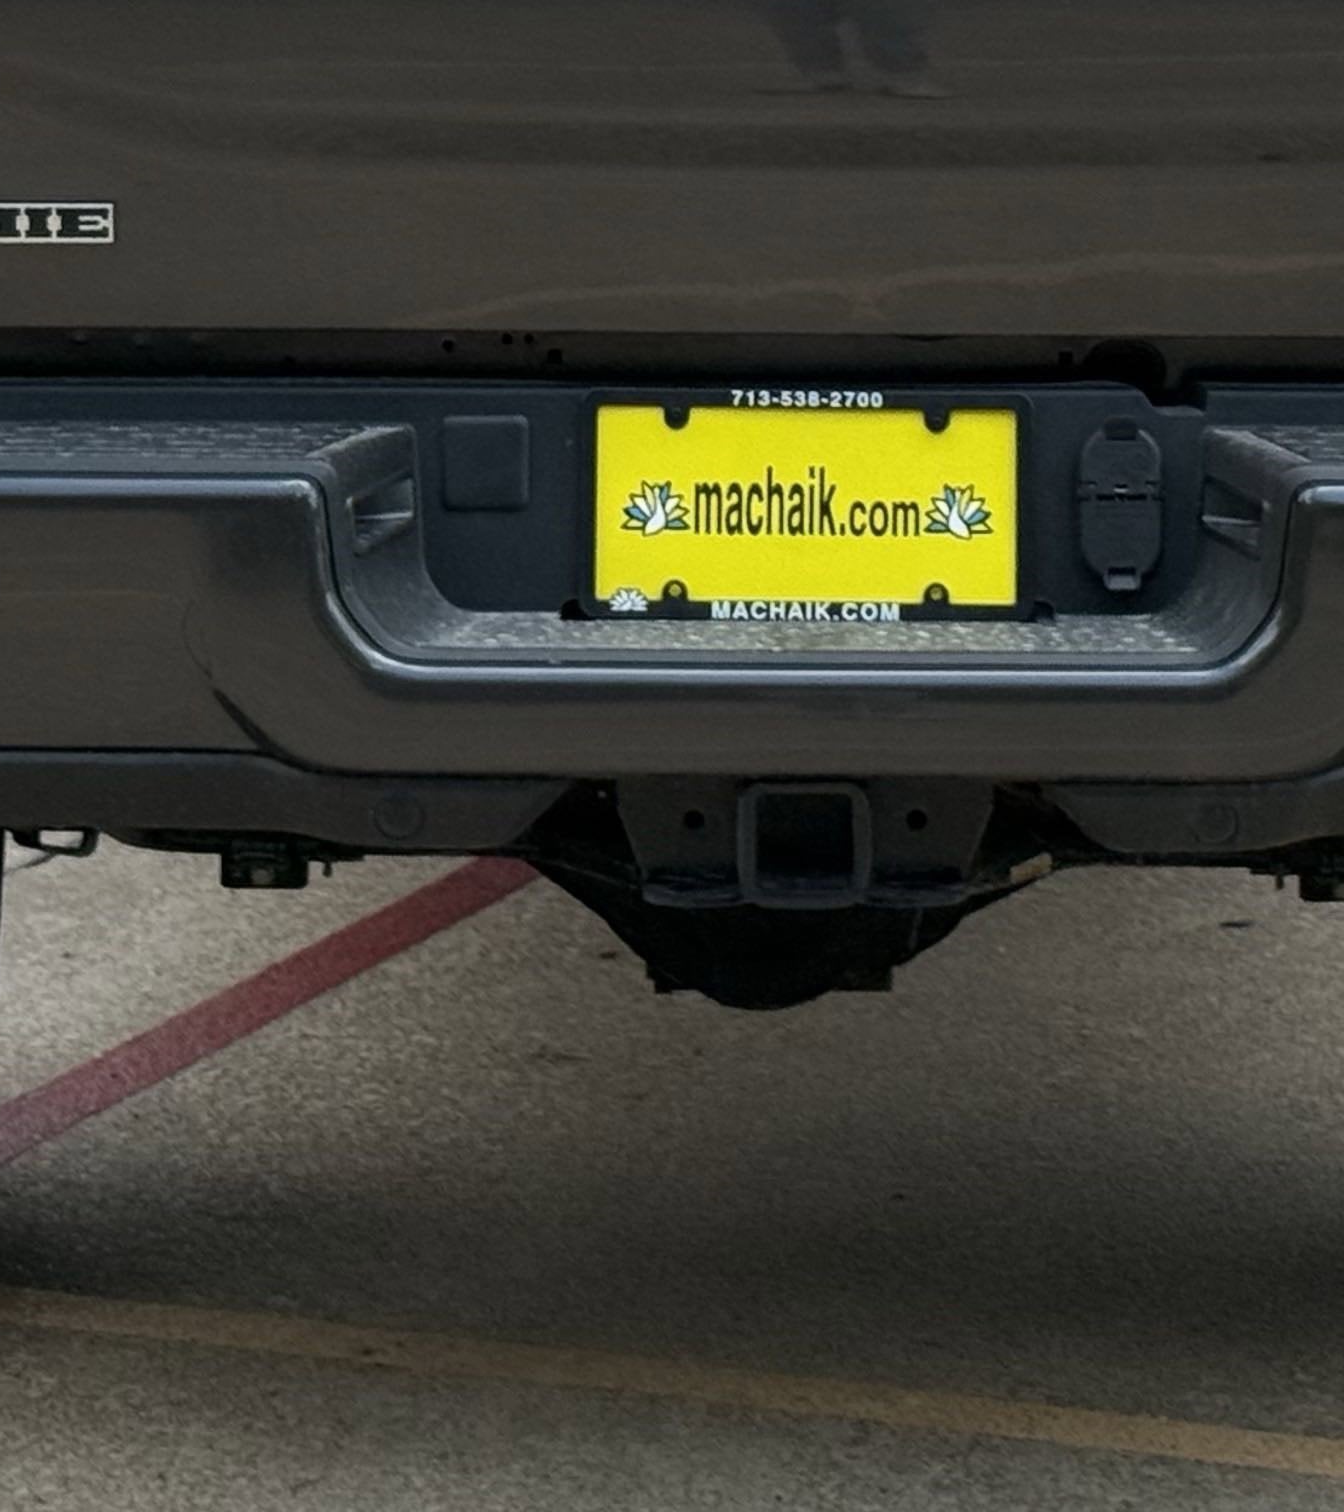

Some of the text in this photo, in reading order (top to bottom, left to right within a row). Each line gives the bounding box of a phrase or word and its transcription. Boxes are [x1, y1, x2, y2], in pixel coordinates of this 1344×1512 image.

[731, 390, 884, 408] 713-538-2700
[694, 466, 921, 537] machaik.com
[711, 600, 900, 622] MACHAIK.COM
